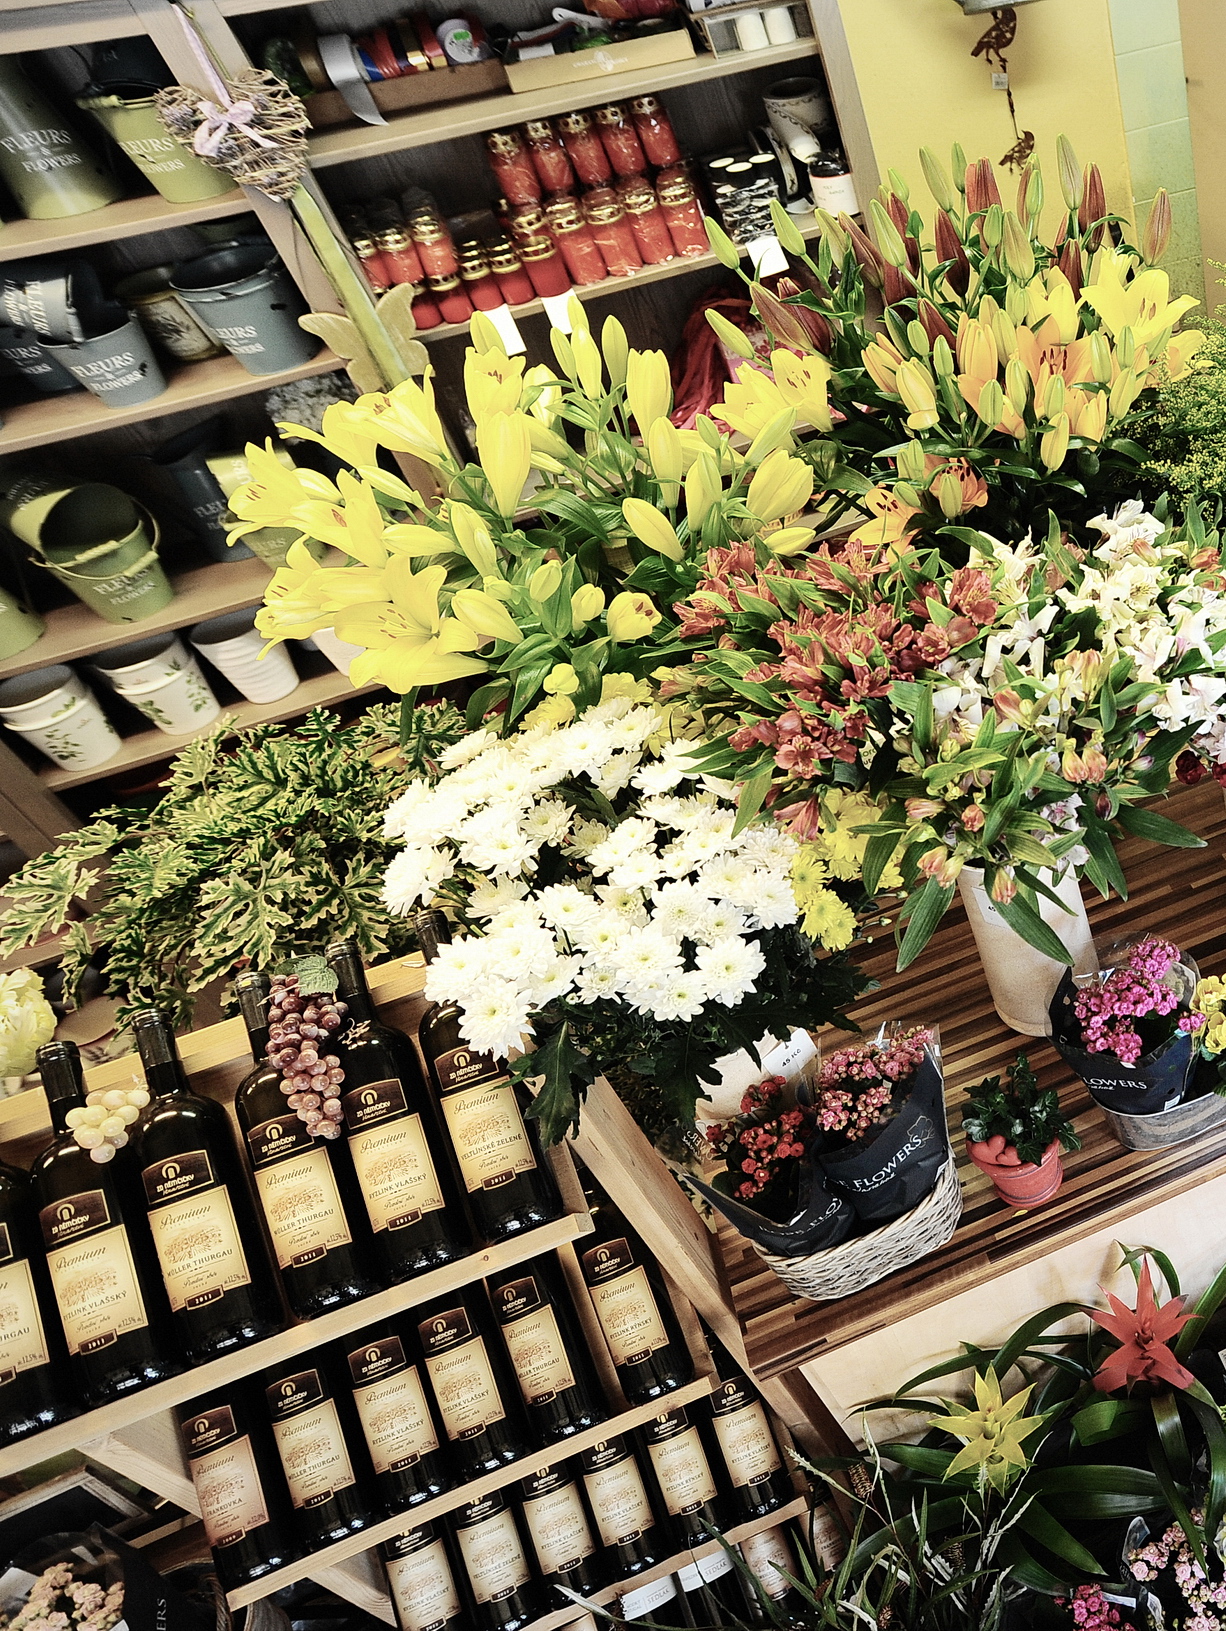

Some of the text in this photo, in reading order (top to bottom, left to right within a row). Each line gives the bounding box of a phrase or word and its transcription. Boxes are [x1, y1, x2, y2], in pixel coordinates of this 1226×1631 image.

[0, 129, 72, 154] FLEURS
[118, 137, 174, 155] LEURS
[21, 153, 82, 173] FLOWERS
[70, 352, 135, 378] FLEURS
[90, 370, 144, 391] FLOWERS
[781, 1057, 791, 1067] 45
[1083, 1075, 1148, 1090] LOWERS
[853, 1134, 922, 1189] FLOWERS
